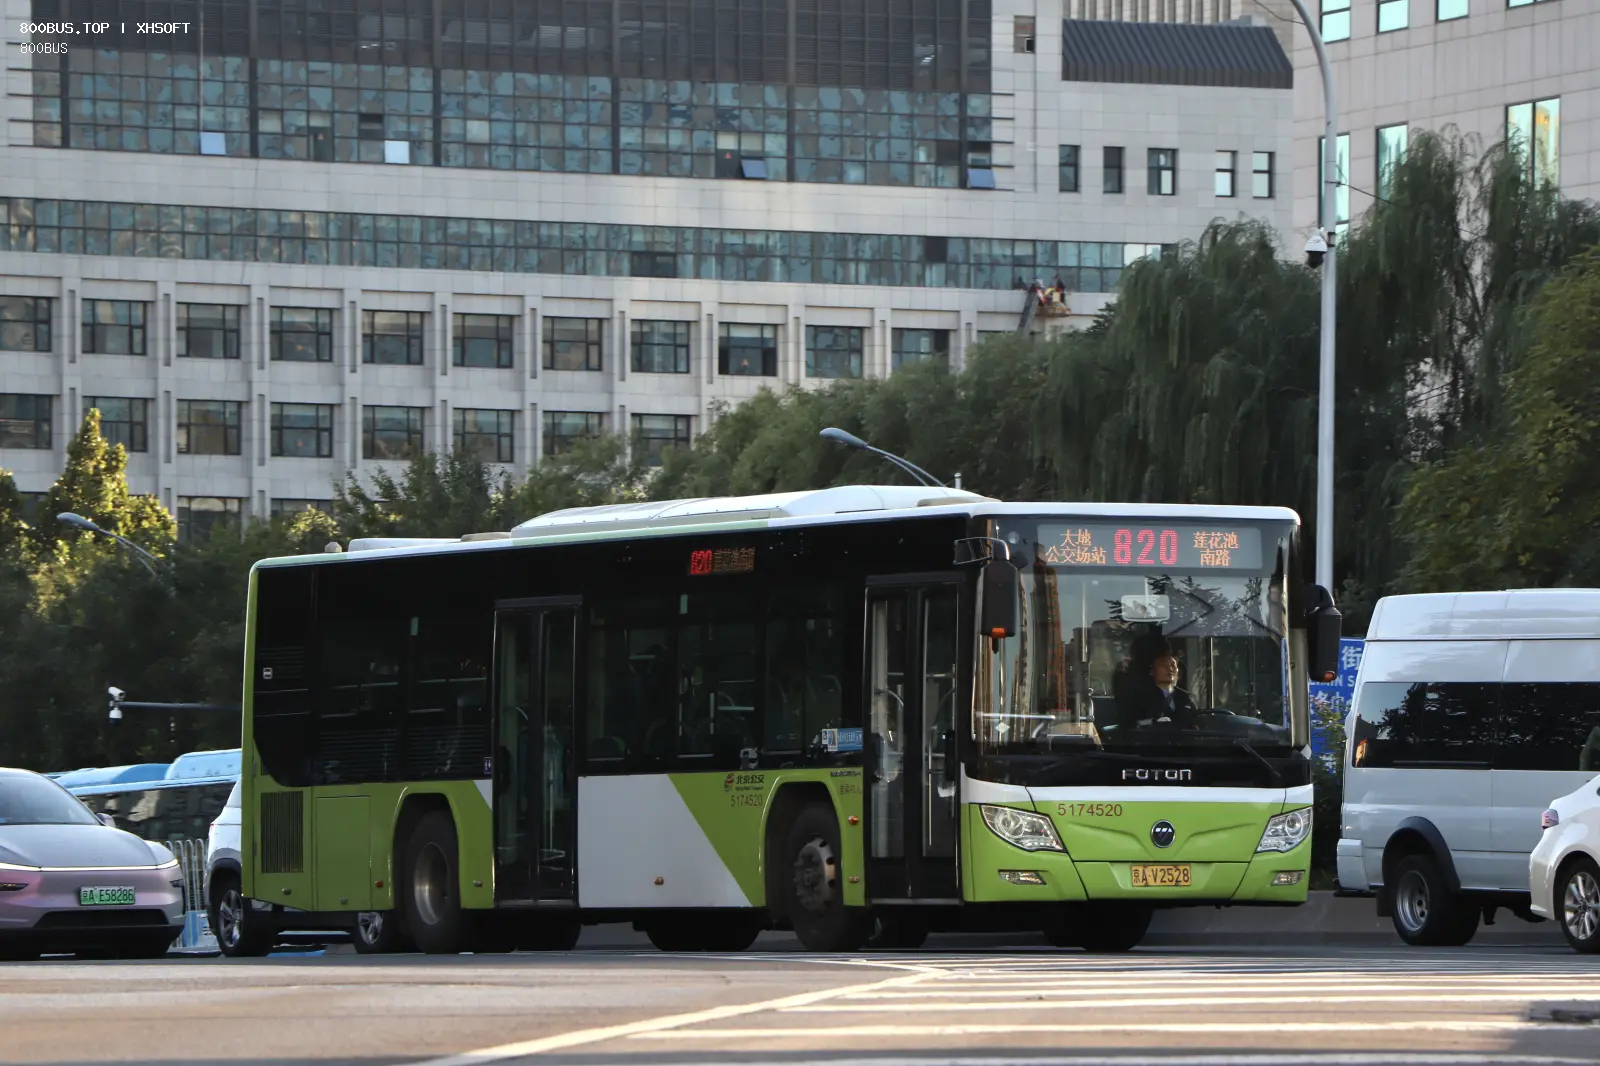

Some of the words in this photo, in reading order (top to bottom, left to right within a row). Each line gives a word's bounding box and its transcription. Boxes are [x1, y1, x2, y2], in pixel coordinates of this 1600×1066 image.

[1060, 528, 1092, 547] 大地
[1193, 531, 1239, 549] 莲花池
[1045, 546, 1106, 565] 公交场站
[1113, 528, 1178, 566] 820
[1200, 549, 1231, 567] 南路
[736, 774, 764, 784] 北京公交
[1122, 769, 1192, 780] FOTON
[731, 794, 763, 807] 5174520
[1057, 804, 1123, 817] 5174520
